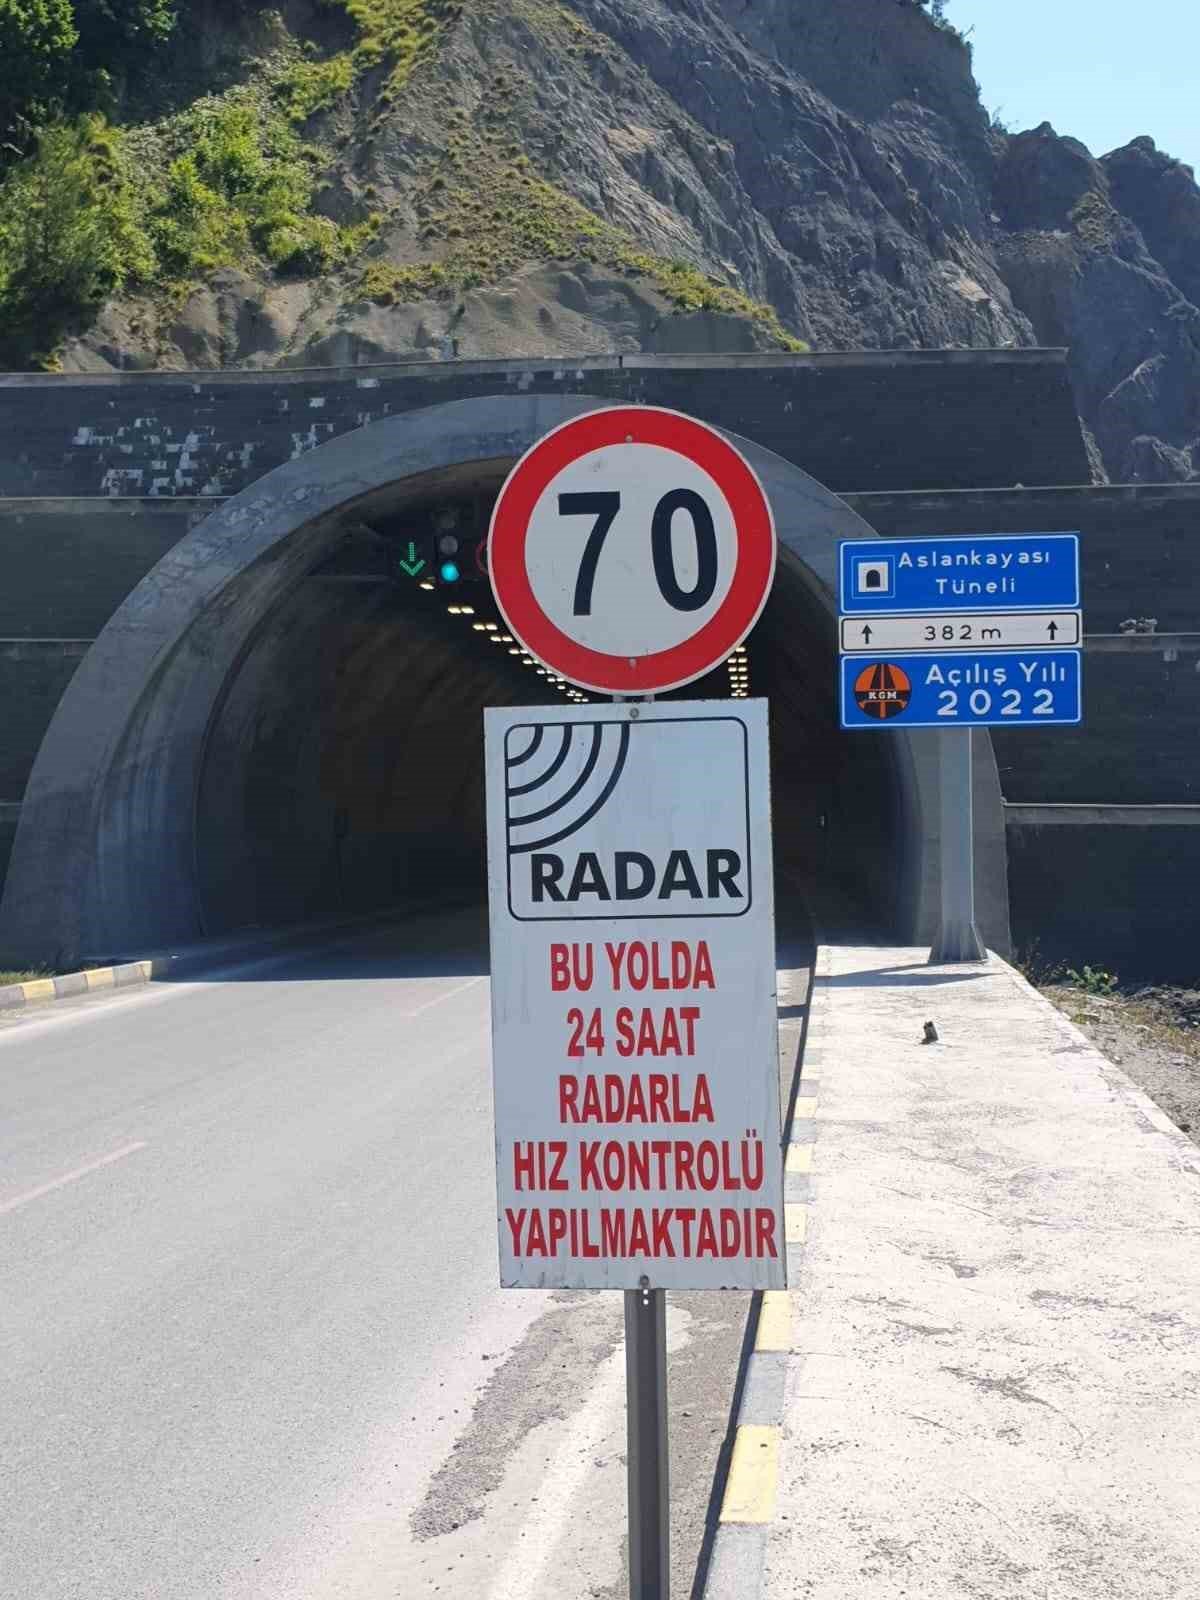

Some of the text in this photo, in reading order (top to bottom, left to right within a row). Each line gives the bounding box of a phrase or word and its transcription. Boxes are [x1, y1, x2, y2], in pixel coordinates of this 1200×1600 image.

[558, 488, 718, 616] 70
[898, 549, 1050, 569] Aslankayası
[935, 577, 1016, 595] Tüneli
[924, 624, 1002, 641] 382 m
[868, 691, 897, 700] KGM
[925, 661, 1065, 687] Açılış Yılı
[937, 688, 1055, 716] 2022
[530, 849, 744, 902] RADAR
[550, 940, 716, 992] BU YOLDA
[567, 1006, 700, 1057] 24 SAAT
[558, 1073, 715, 1123] RADARLA
[513, 1128, 765, 1191] HIZ KONTROLÜ
[505, 1207, 778, 1258] YAPILMAKTADIR
